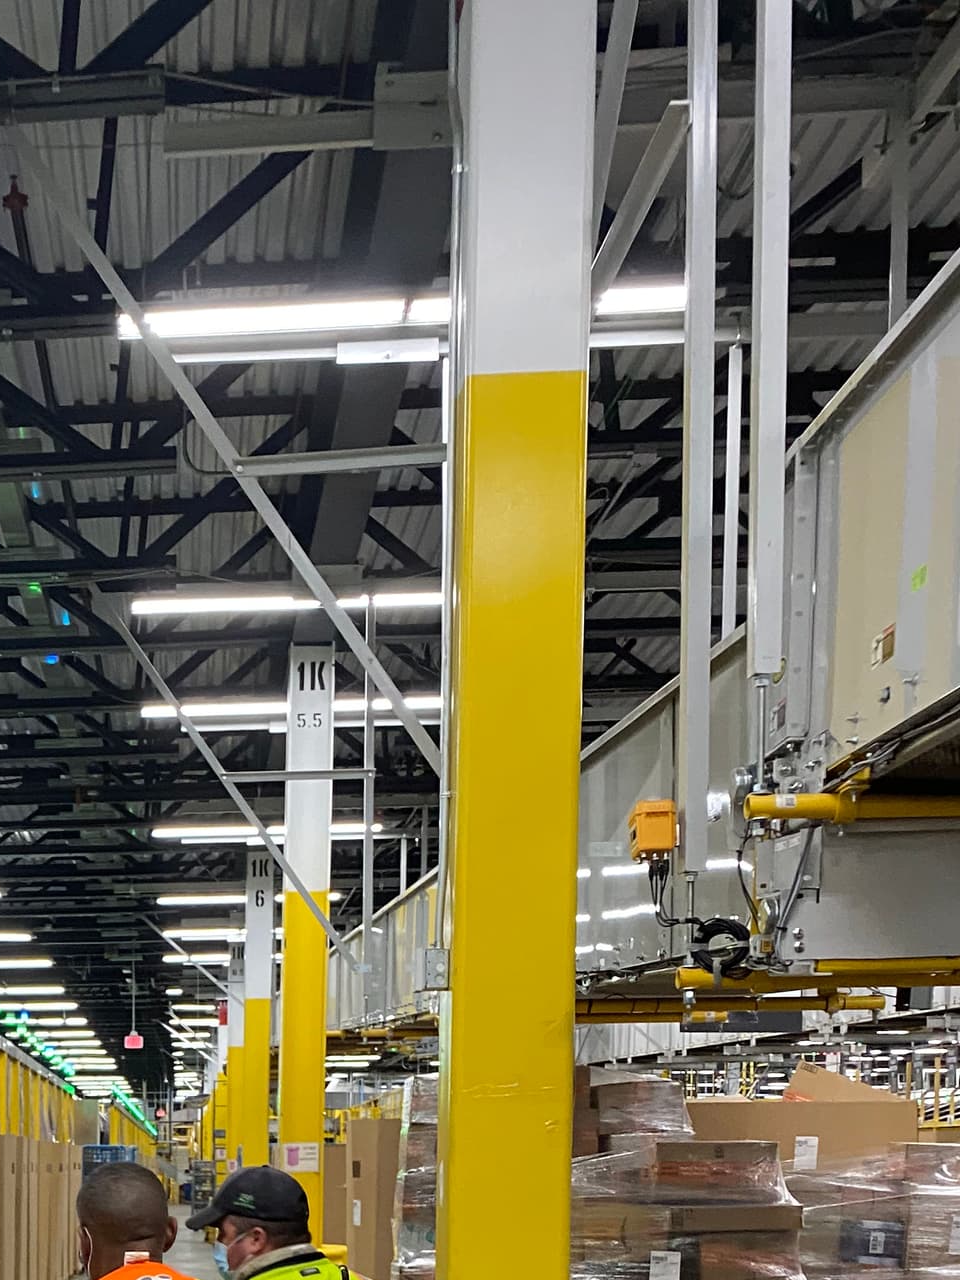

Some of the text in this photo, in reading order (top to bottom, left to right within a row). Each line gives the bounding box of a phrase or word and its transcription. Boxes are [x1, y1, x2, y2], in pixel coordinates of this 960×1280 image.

[296, 661, 326, 691] 1K
[296, 713, 322, 728] 5.5
[251, 859, 269, 878] 1K
[255, 889, 265, 908] 6
